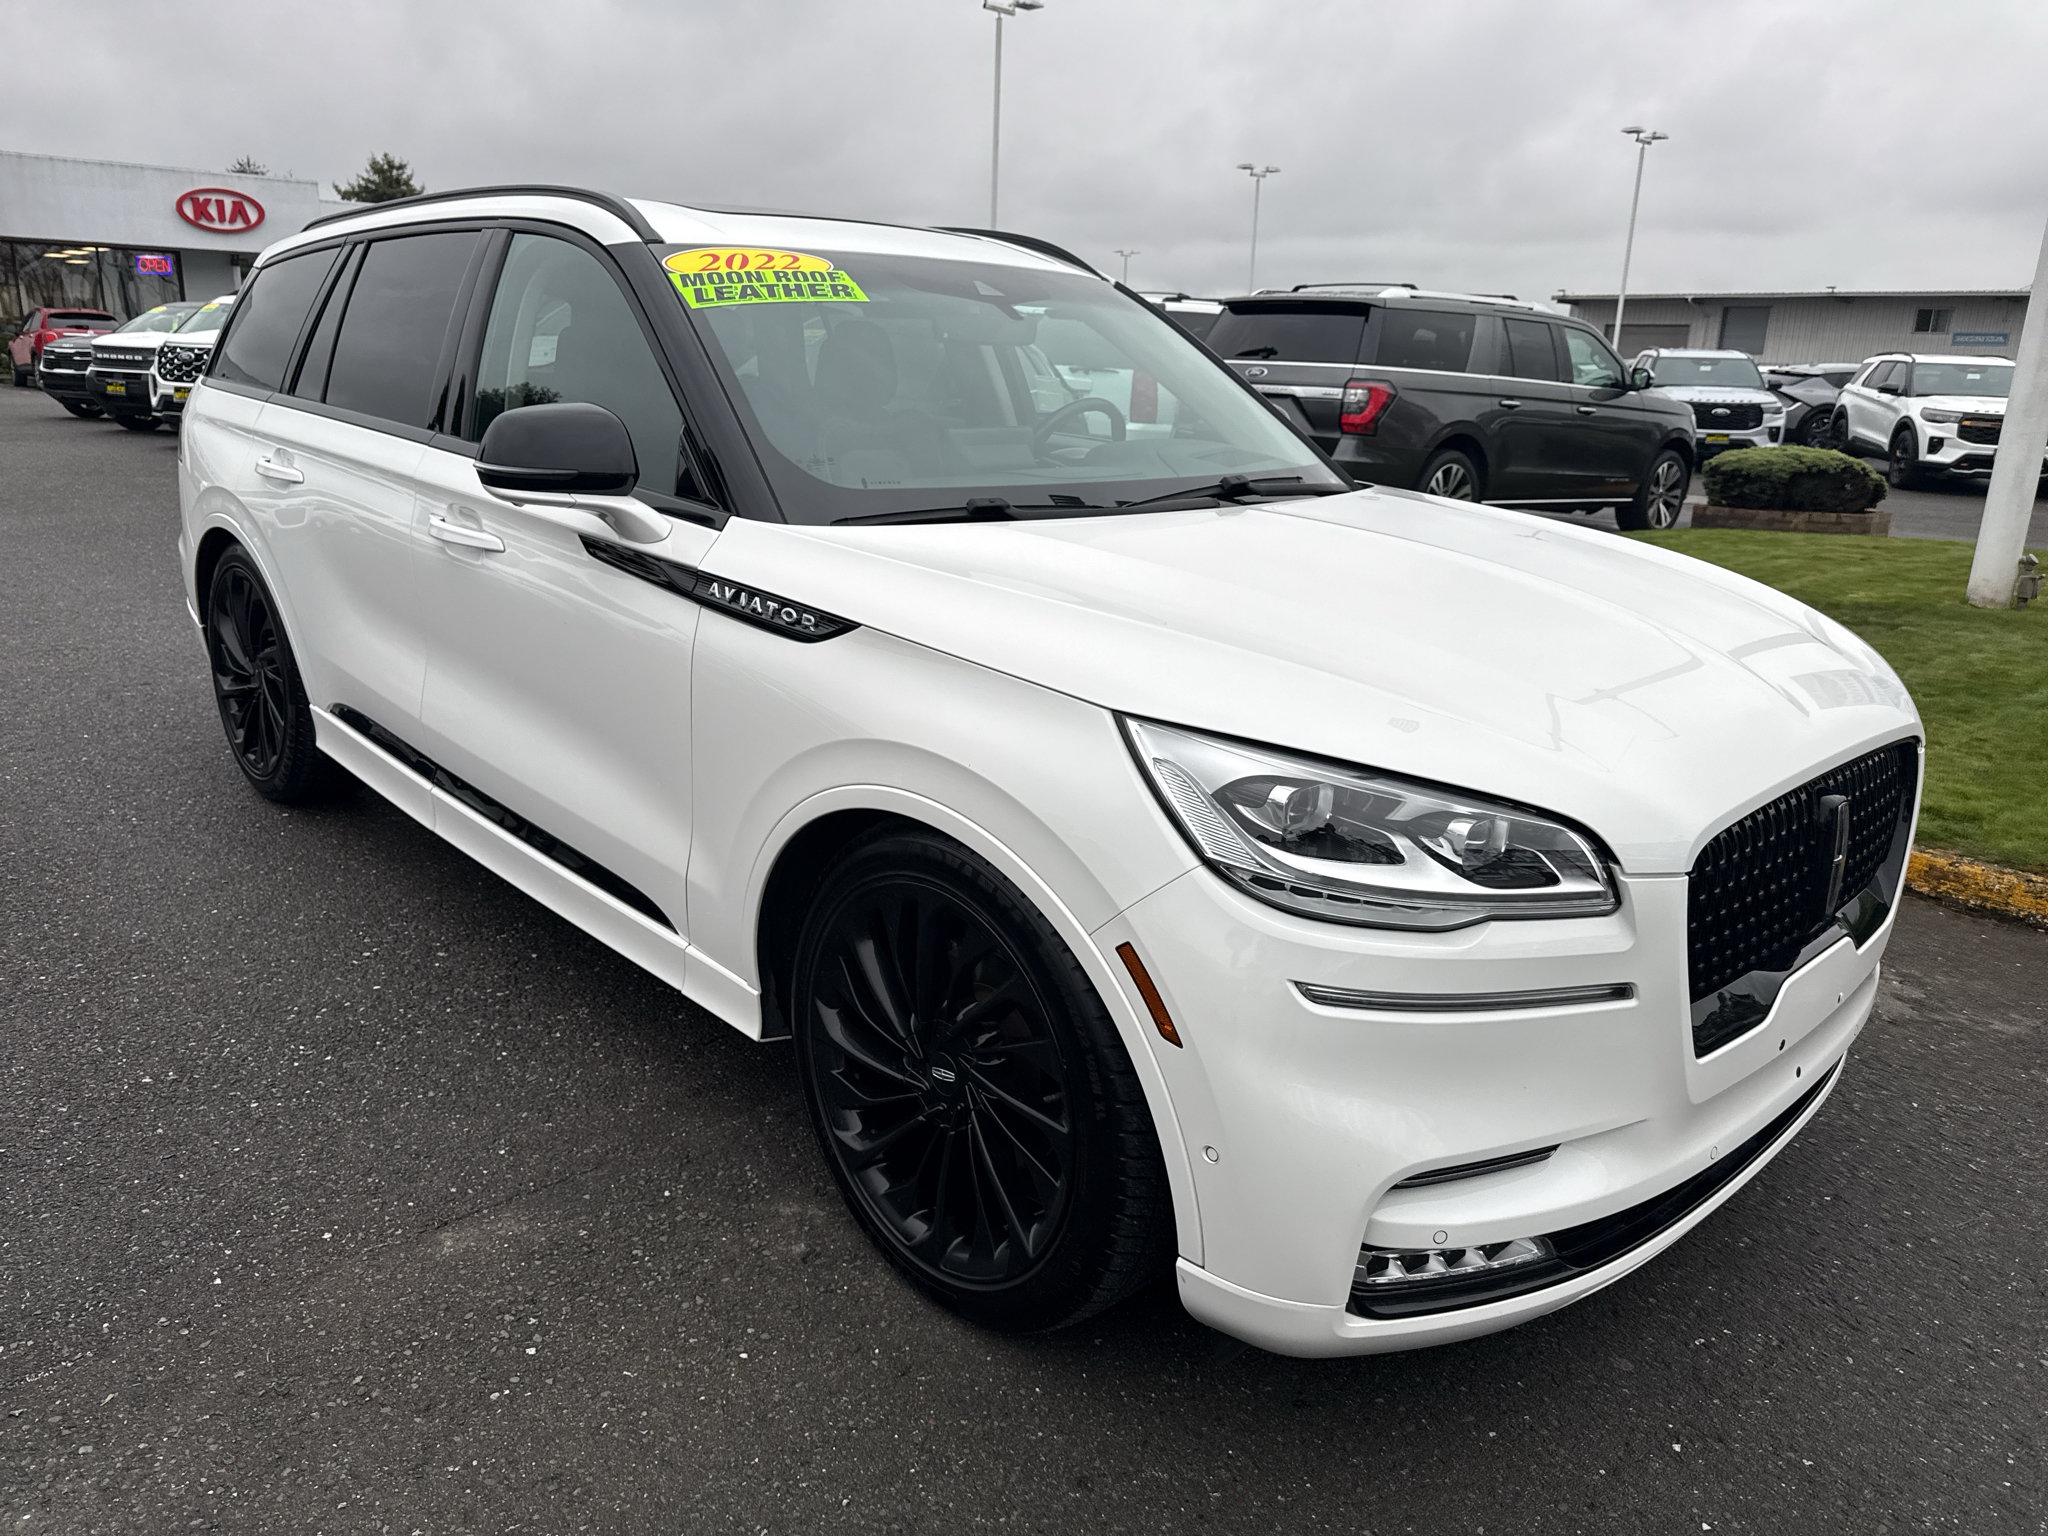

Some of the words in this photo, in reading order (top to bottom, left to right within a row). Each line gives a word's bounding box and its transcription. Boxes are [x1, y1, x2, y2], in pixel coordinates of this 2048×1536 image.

[190, 197, 252, 225] KIA
[138, 257, 171, 273] OPEN
[698, 252, 802, 271] 2022
[680, 270, 768, 287] MOON
[775, 270, 846, 284] ROOF
[693, 283, 855, 304] LEATHER
[708, 582, 816, 632] AVIATOR
